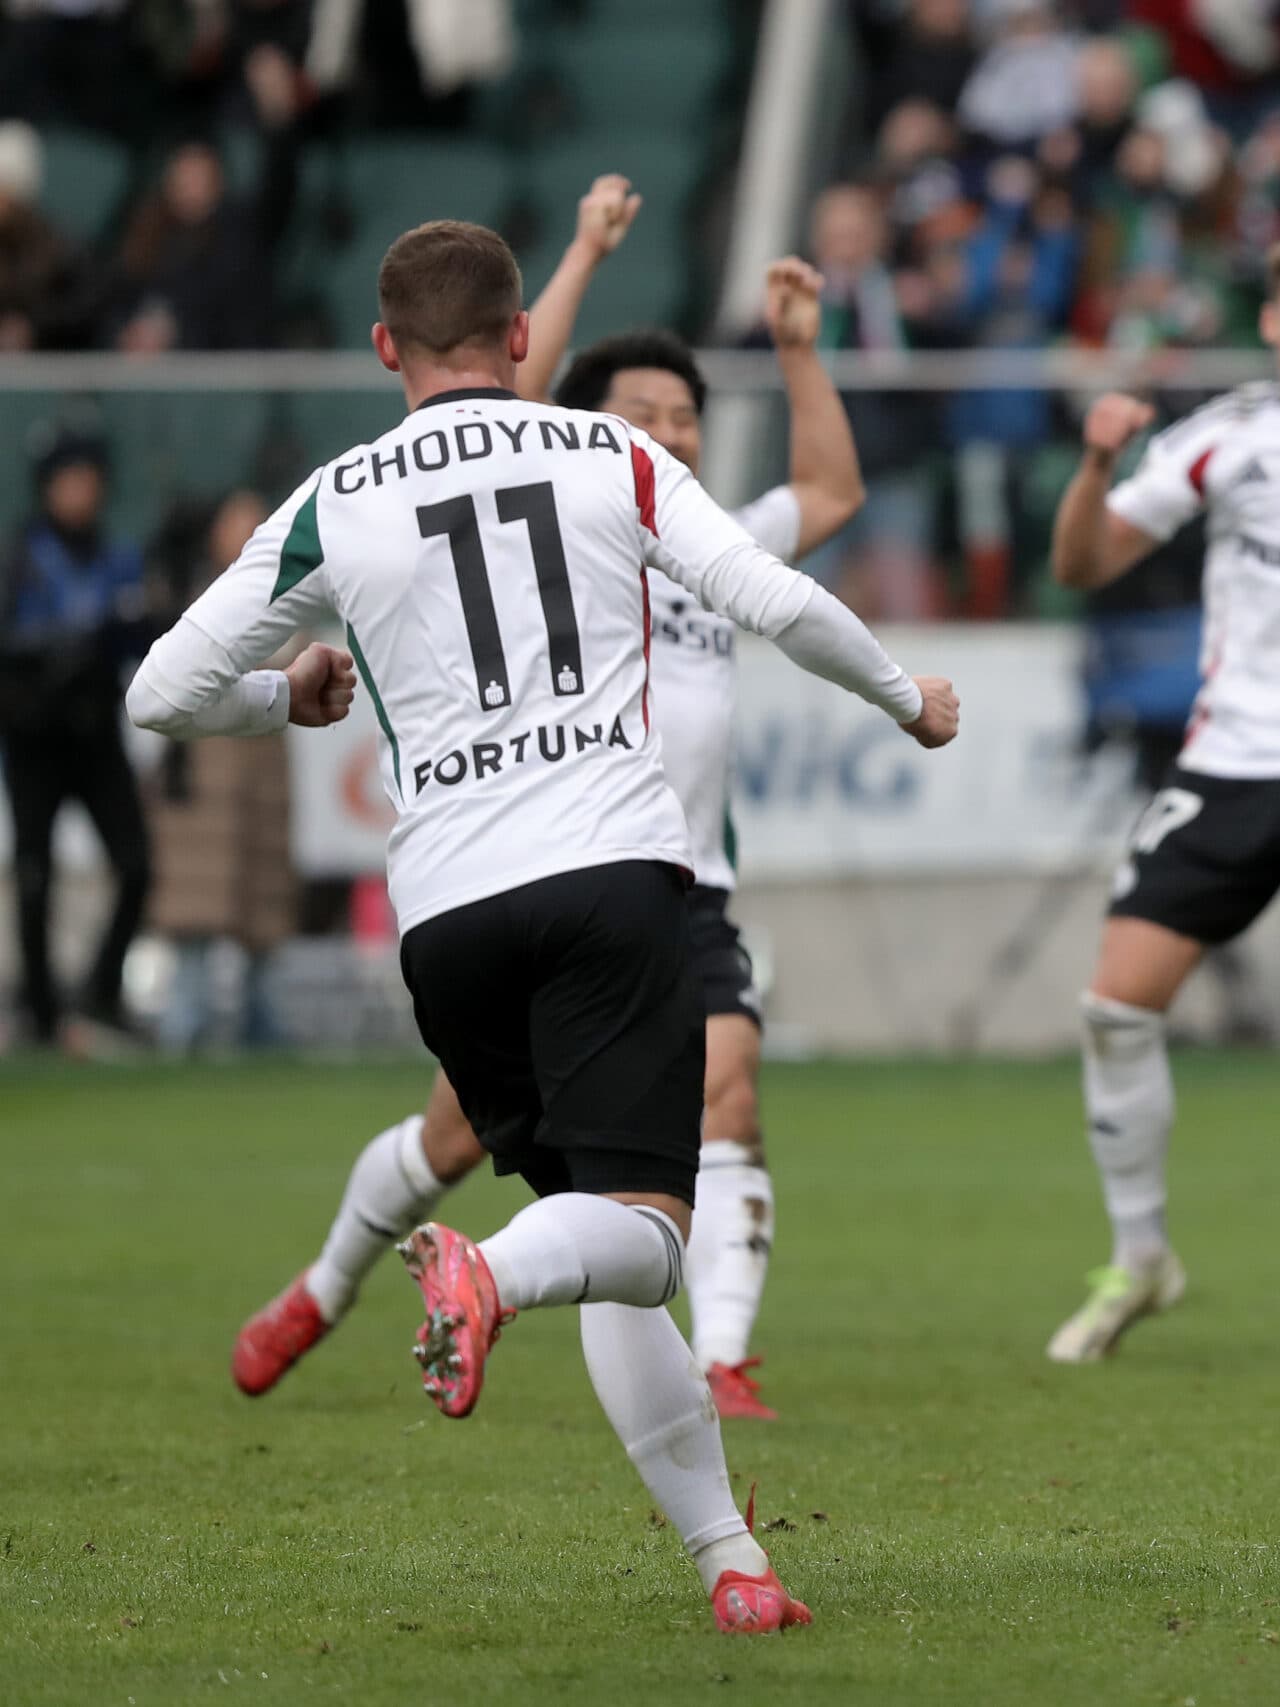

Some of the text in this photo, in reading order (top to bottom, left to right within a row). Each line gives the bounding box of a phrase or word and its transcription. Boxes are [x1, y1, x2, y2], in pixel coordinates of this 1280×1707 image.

[334, 420, 623, 495] CHODYNA
[415, 480, 585, 712] 11
[413, 714, 633, 795] FORTUNA
